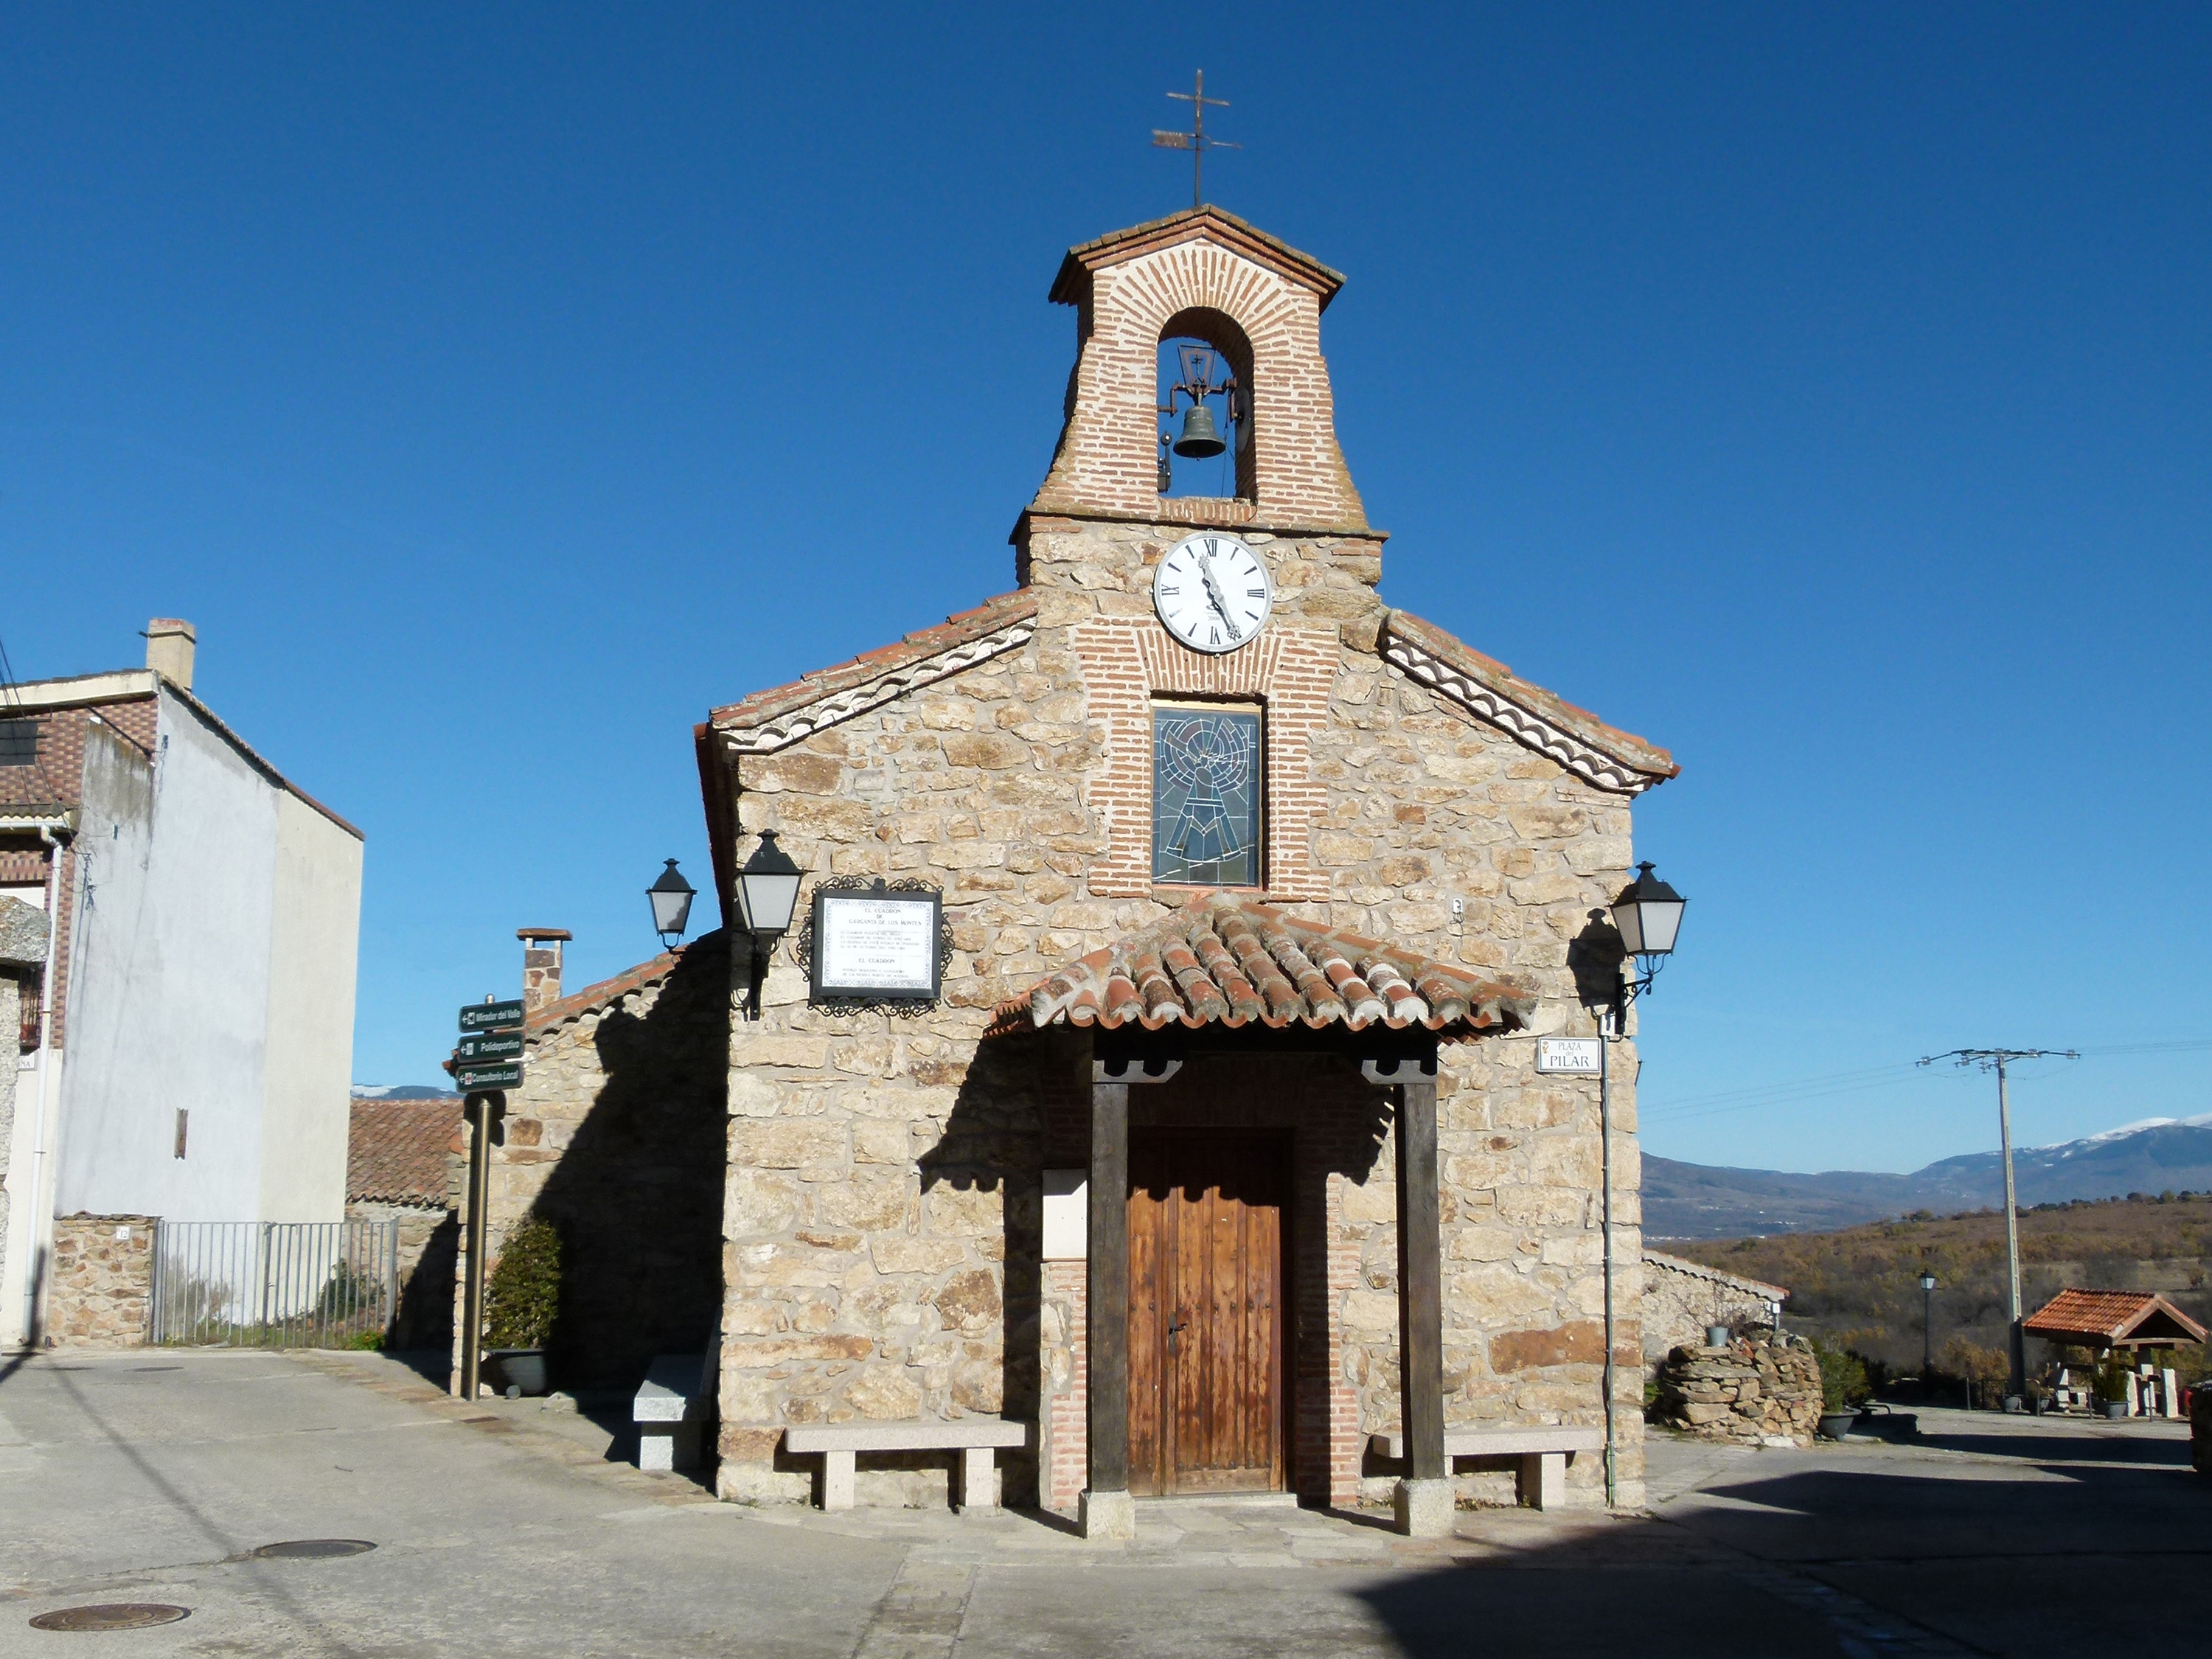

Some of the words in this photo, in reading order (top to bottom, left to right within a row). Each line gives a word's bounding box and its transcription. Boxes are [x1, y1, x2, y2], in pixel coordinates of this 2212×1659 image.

[1203, 539, 1218, 557] XII
[1247, 588, 1265, 599] III
[498, 1010, 507, 1020] del
[481, 1040, 519, 1051] Polideportivo
[1558, 1042, 1582, 1051] PLAZA
[1550, 1056, 1589, 1067] PILAR
[503, 1069, 518, 1079] Local
[121, 1230, 128, 1238] 12
